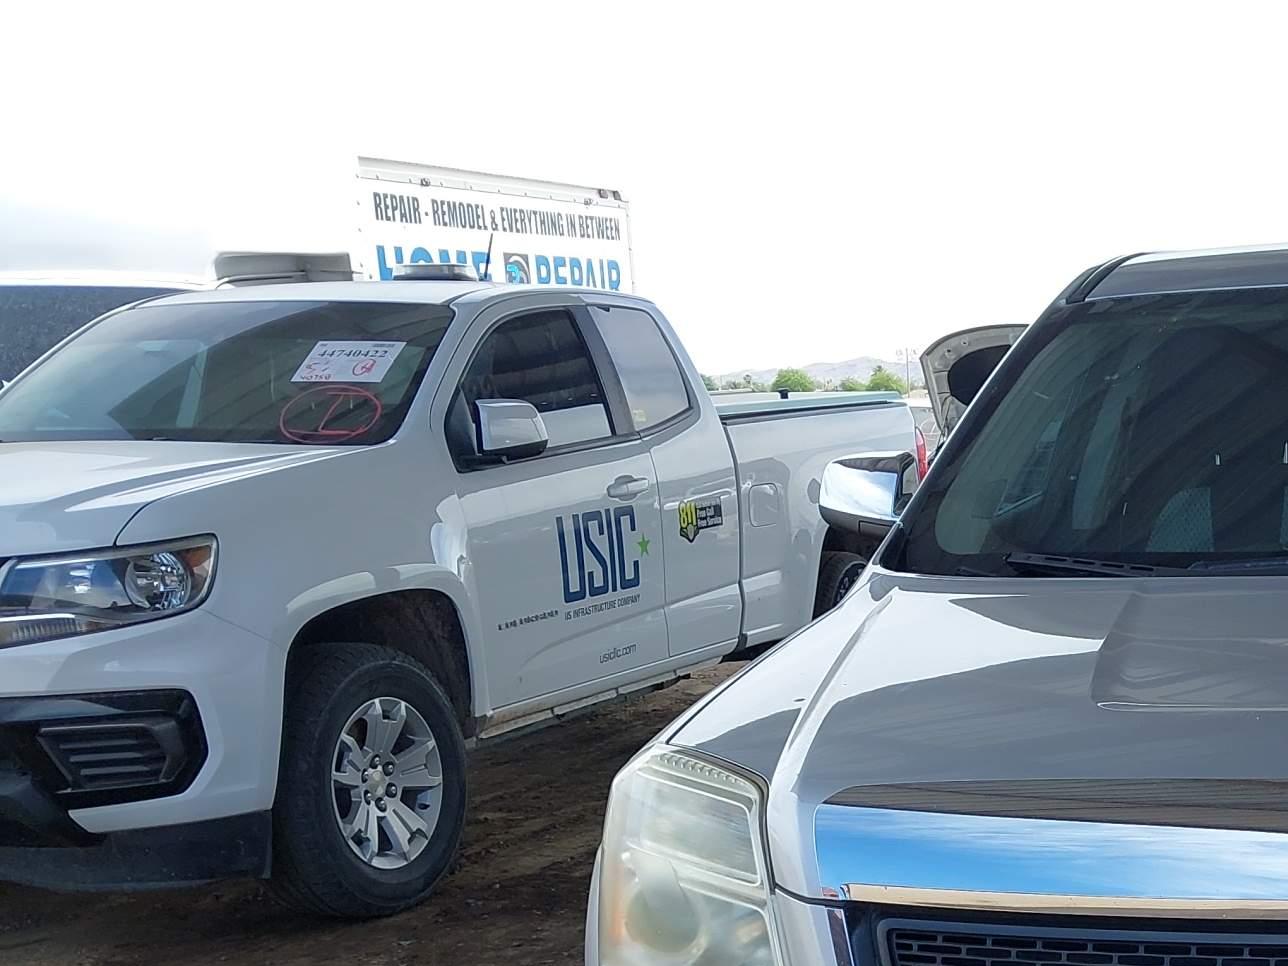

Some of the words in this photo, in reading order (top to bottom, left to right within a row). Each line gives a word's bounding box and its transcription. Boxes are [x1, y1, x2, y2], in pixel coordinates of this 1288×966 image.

[373, 191, 422, 225] REPAIR
[431, 198, 488, 231] REMODEL
[490, 209, 499, 231] &
[499, 206, 565, 237] EVERYTHING
[566, 213, 577, 238] IN
[578, 215, 621, 241] BETWEEN
[318, 349, 389, 358] 44740422
[680, 501, 697, 528] 811
[556, 505, 640, 604] USIC
[564, 609, 572, 620] US
[573, 600, 616, 619] INFRASTRUCTURE
[618, 594, 641, 608] COMPANY
